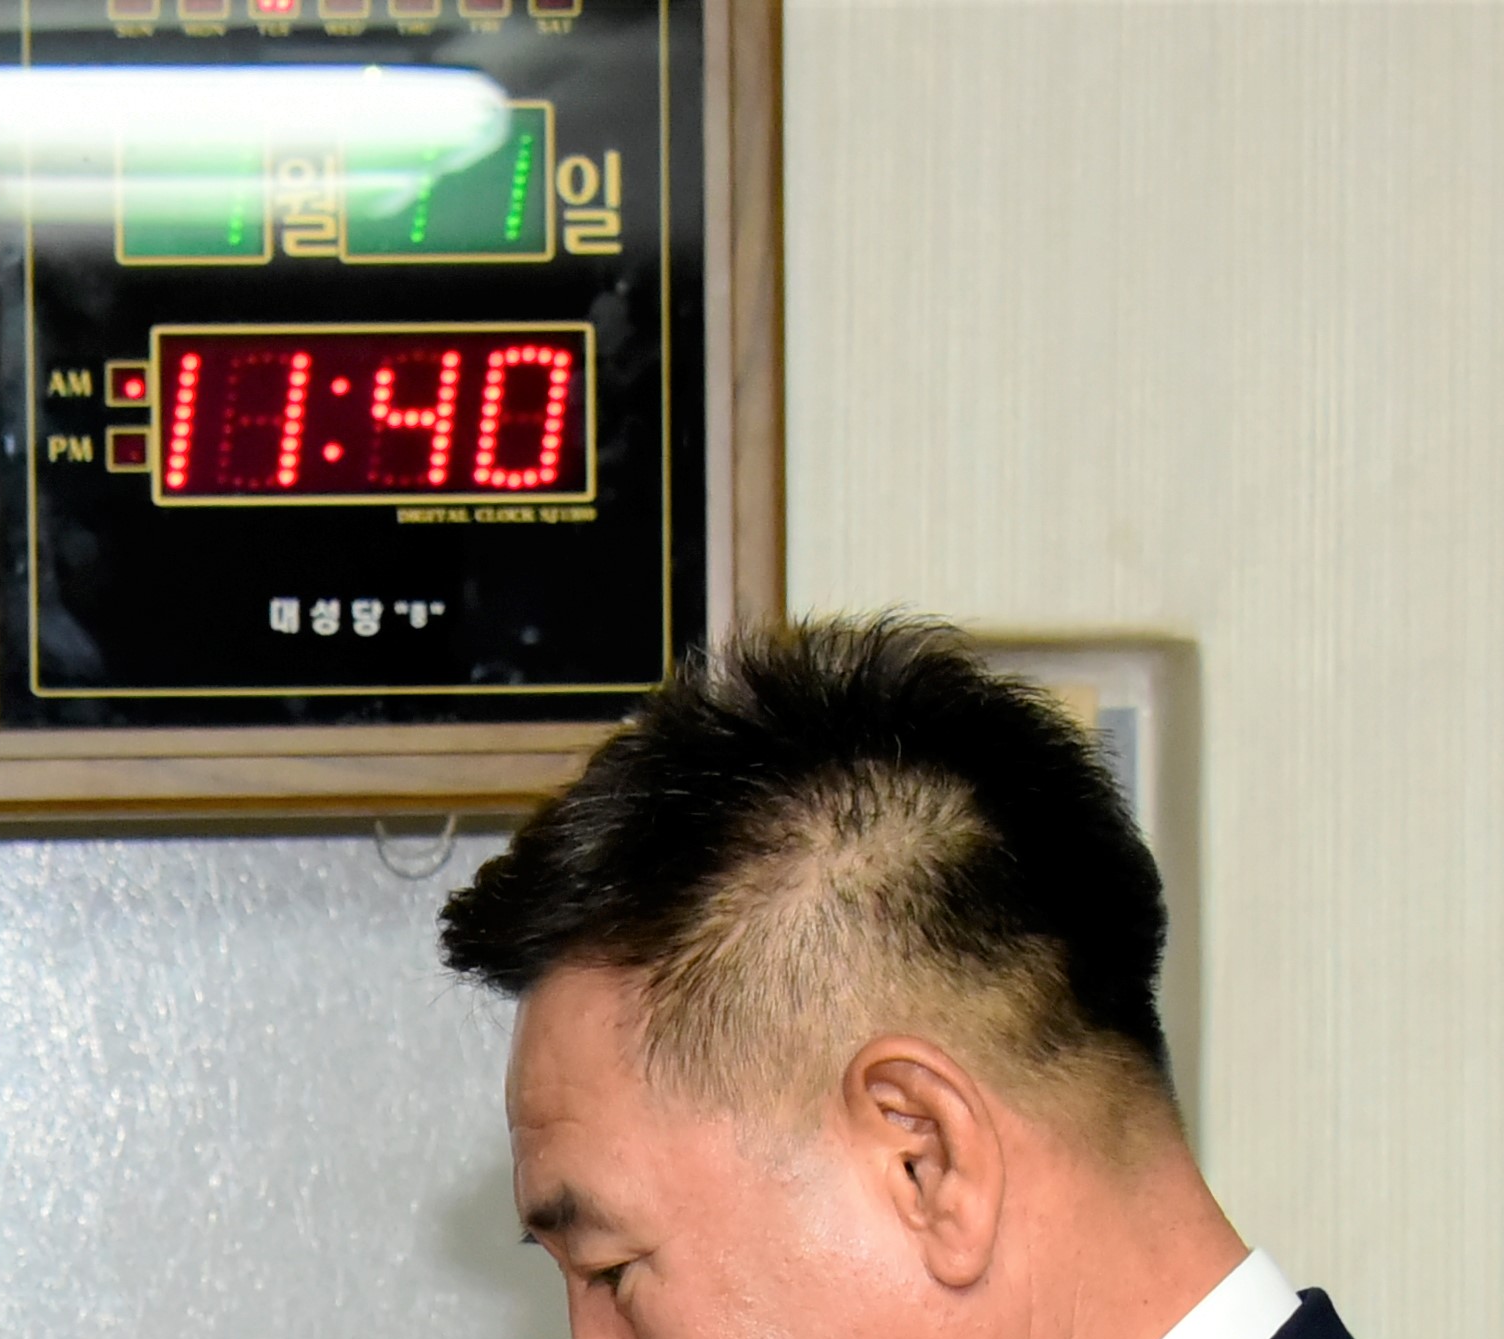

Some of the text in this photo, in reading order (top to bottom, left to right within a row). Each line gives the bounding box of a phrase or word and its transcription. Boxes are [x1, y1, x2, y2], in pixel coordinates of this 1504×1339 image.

[555, 148, 623, 256] 일
[48, 369, 93, 399] AM
[165, 345, 573, 490] 11:40
[48, 435, 93, 465] PM
